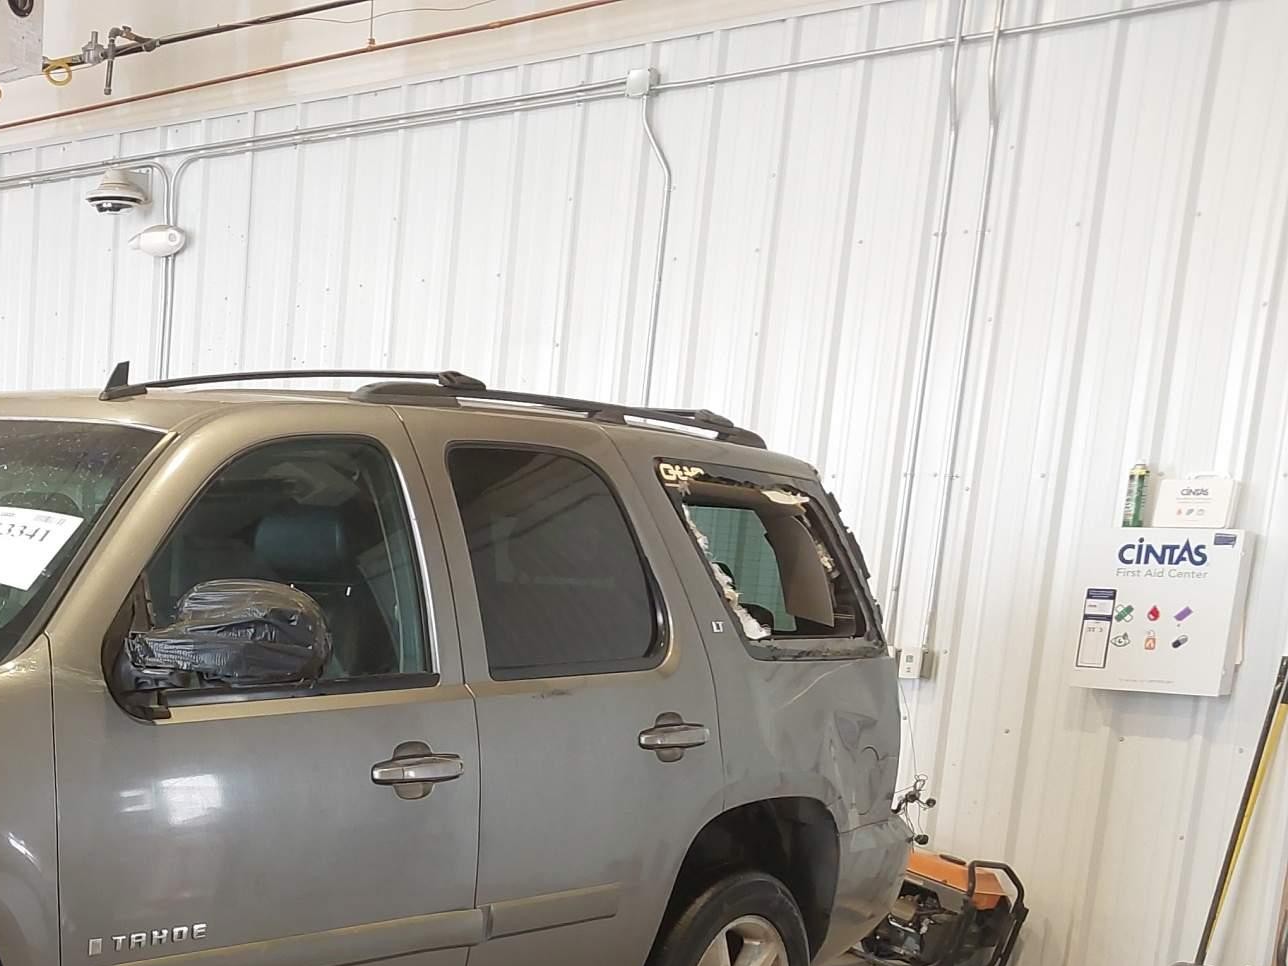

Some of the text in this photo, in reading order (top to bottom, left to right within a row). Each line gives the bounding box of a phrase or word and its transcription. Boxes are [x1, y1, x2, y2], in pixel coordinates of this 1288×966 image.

[1116, 568, 1209, 579] First Aid Center
[711, 621, 724, 633] LT
[112, 922, 208, 952] TAHOE
